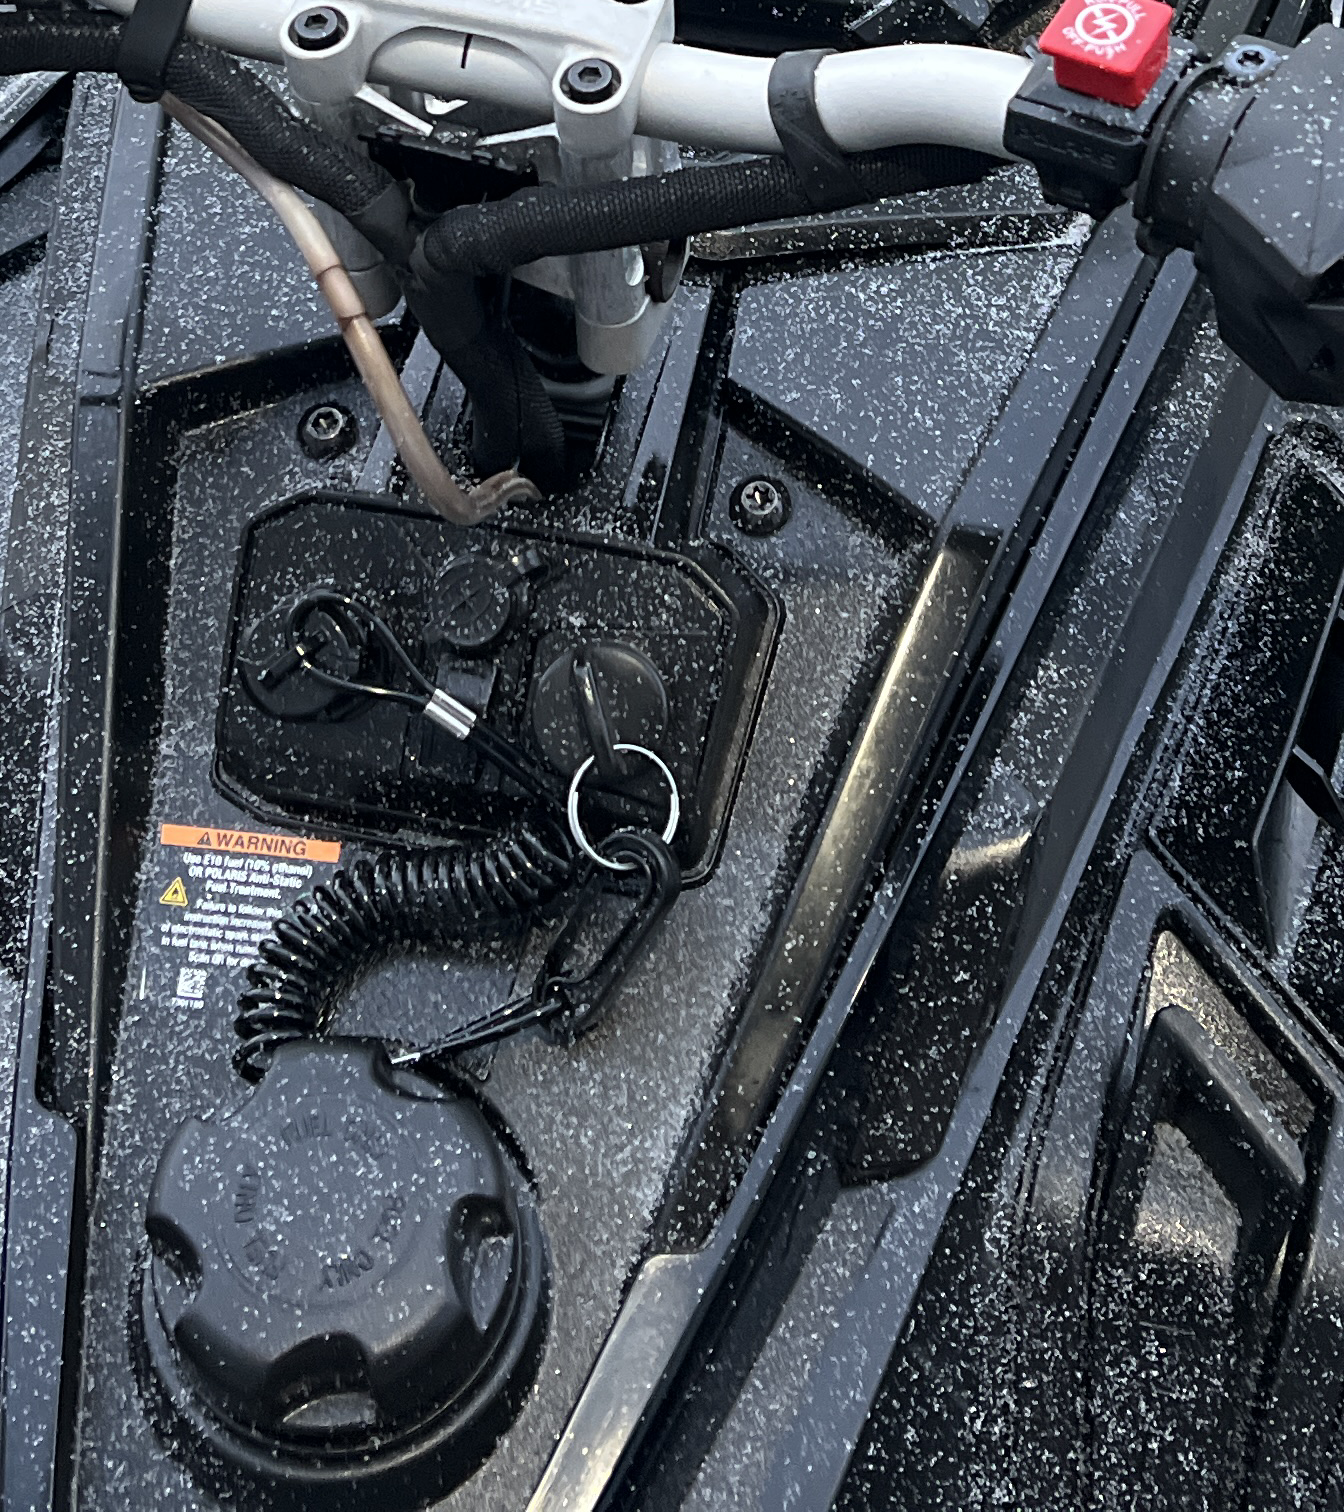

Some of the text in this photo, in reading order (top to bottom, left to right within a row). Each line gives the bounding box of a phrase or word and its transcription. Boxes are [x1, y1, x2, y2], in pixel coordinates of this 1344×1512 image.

[216, 832, 307, 856] WARNING
[182, 852, 313, 879] Use E10 fuel (10% ethanol)
[188, 864, 302, 888] OR POLARIS Anti-Static
[195, 898, 226, 912] Failure
[227, 902, 237, 913] to
[238, 903, 266, 917] follow
[183, 910, 230, 927] instruction
[160, 922, 172, 932] of
[171, 923, 224, 938] electrostatic
[160, 935, 170, 946] in
[171, 936, 189, 947] fuel
[209, 940, 234, 953] when
[188, 950, 211, 964] Scan
[211, 953, 226, 965] QR
[226, 955, 240, 967] for
